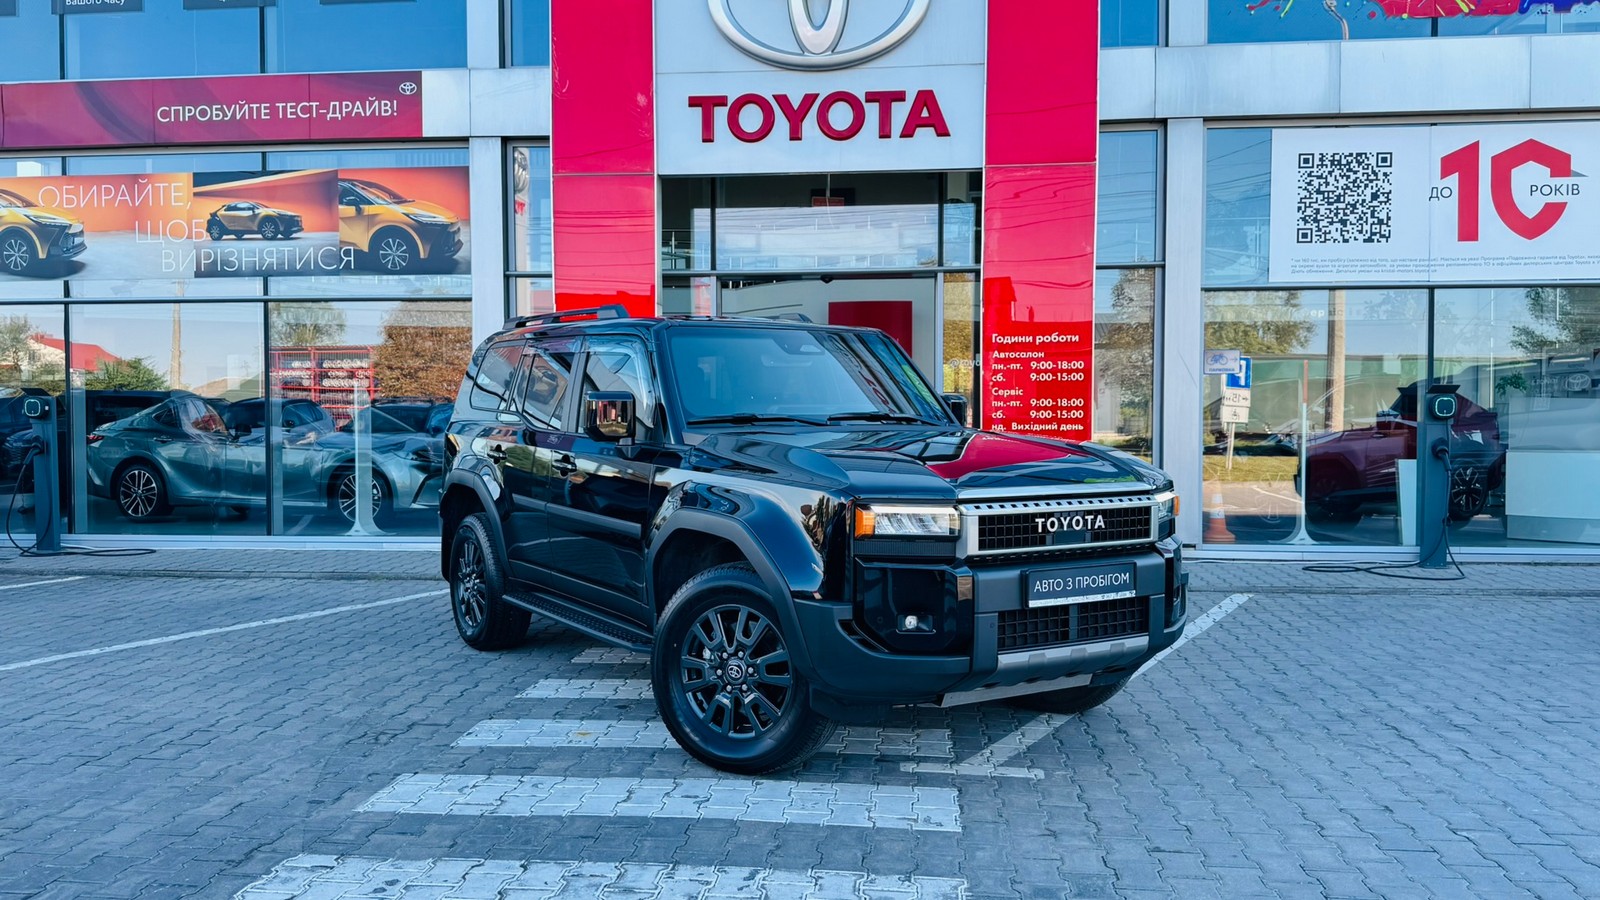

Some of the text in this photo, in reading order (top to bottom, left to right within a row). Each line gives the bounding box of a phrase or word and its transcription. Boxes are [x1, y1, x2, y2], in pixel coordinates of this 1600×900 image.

[156, 93, 399, 123] СПРОБУЙТЕ ТЕСТ-ДРАЙВ!
[688, 89, 951, 143] TOYOTA
[38, 178, 193, 210] ОБИРАЙТЕ,
[1429, 138, 1581, 242] ДО 10 РОКІВ
[135, 218, 207, 246] ЩОБ
[161, 246, 356, 274] ВИРІЗНЯТИСЯ
[991, 332, 1080, 345] Години роботи
[991, 350, 1045, 359] Автосалон
[991, 360, 1085, 371] пн.-пт. 9:00-18:00
[991, 372, 1085, 382] сб. 9:00-15:00
[991, 387, 1024, 397] Сервіс
[991, 398, 1085, 408] пн.-пт. 9:00-18:00
[991, 409, 1085, 419] сб. 9:00-15:00
[991, 421, 1084, 432] нд. Вихідний день
[1035, 515, 1105, 532] TOYOTA
[1034, 579, 1063, 592] АВТО
[1076, 572, 1129, 588] ПРОБІГОМ
